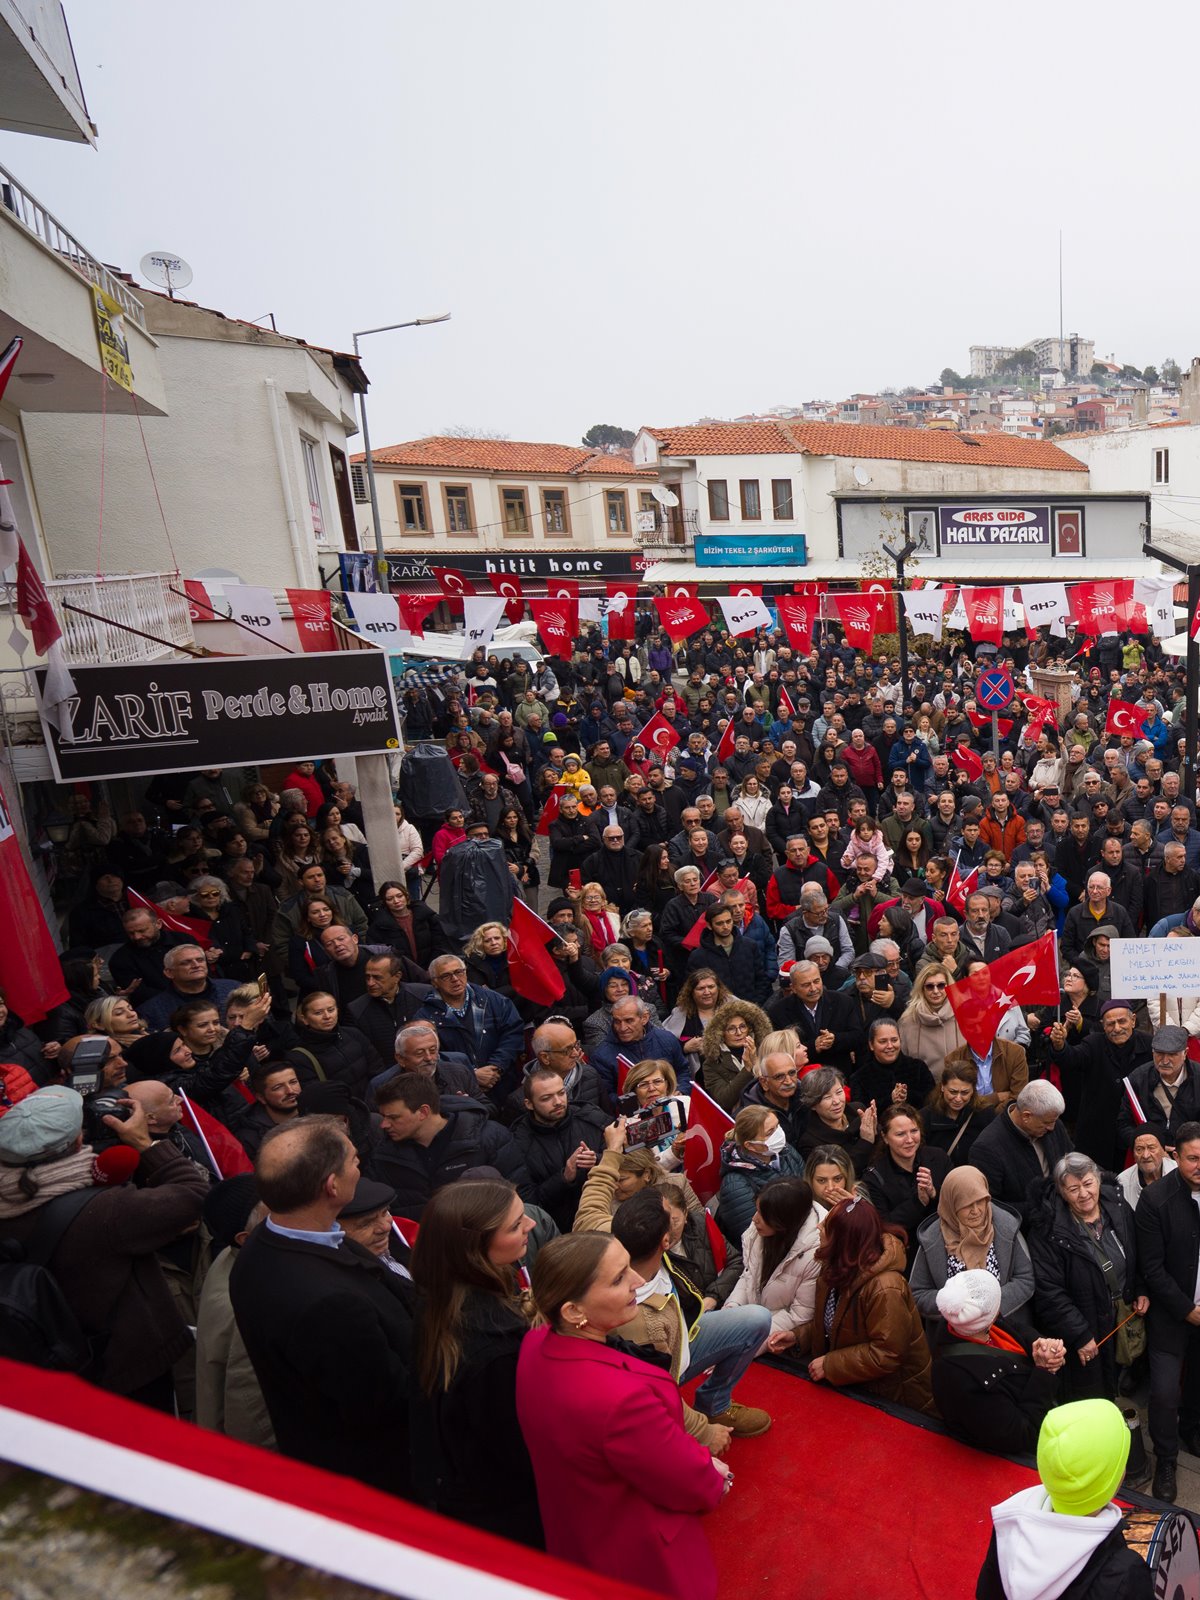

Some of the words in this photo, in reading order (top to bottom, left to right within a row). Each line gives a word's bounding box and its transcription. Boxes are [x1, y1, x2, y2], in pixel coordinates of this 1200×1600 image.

[963, 511, 994, 522] ARAS
[997, 511, 1025, 522] GIDA
[947, 527, 986, 544] HALK
[990, 526, 1043, 544] PAZARI
[391, 565, 436, 577] KARA
[485, 559, 536, 573] hitit
[549, 558, 603, 572] home
[58, 682, 193, 745] ZARİF
[352, 709, 388, 725] Ayvalık
[1122, 943, 1156, 954] AHMET
